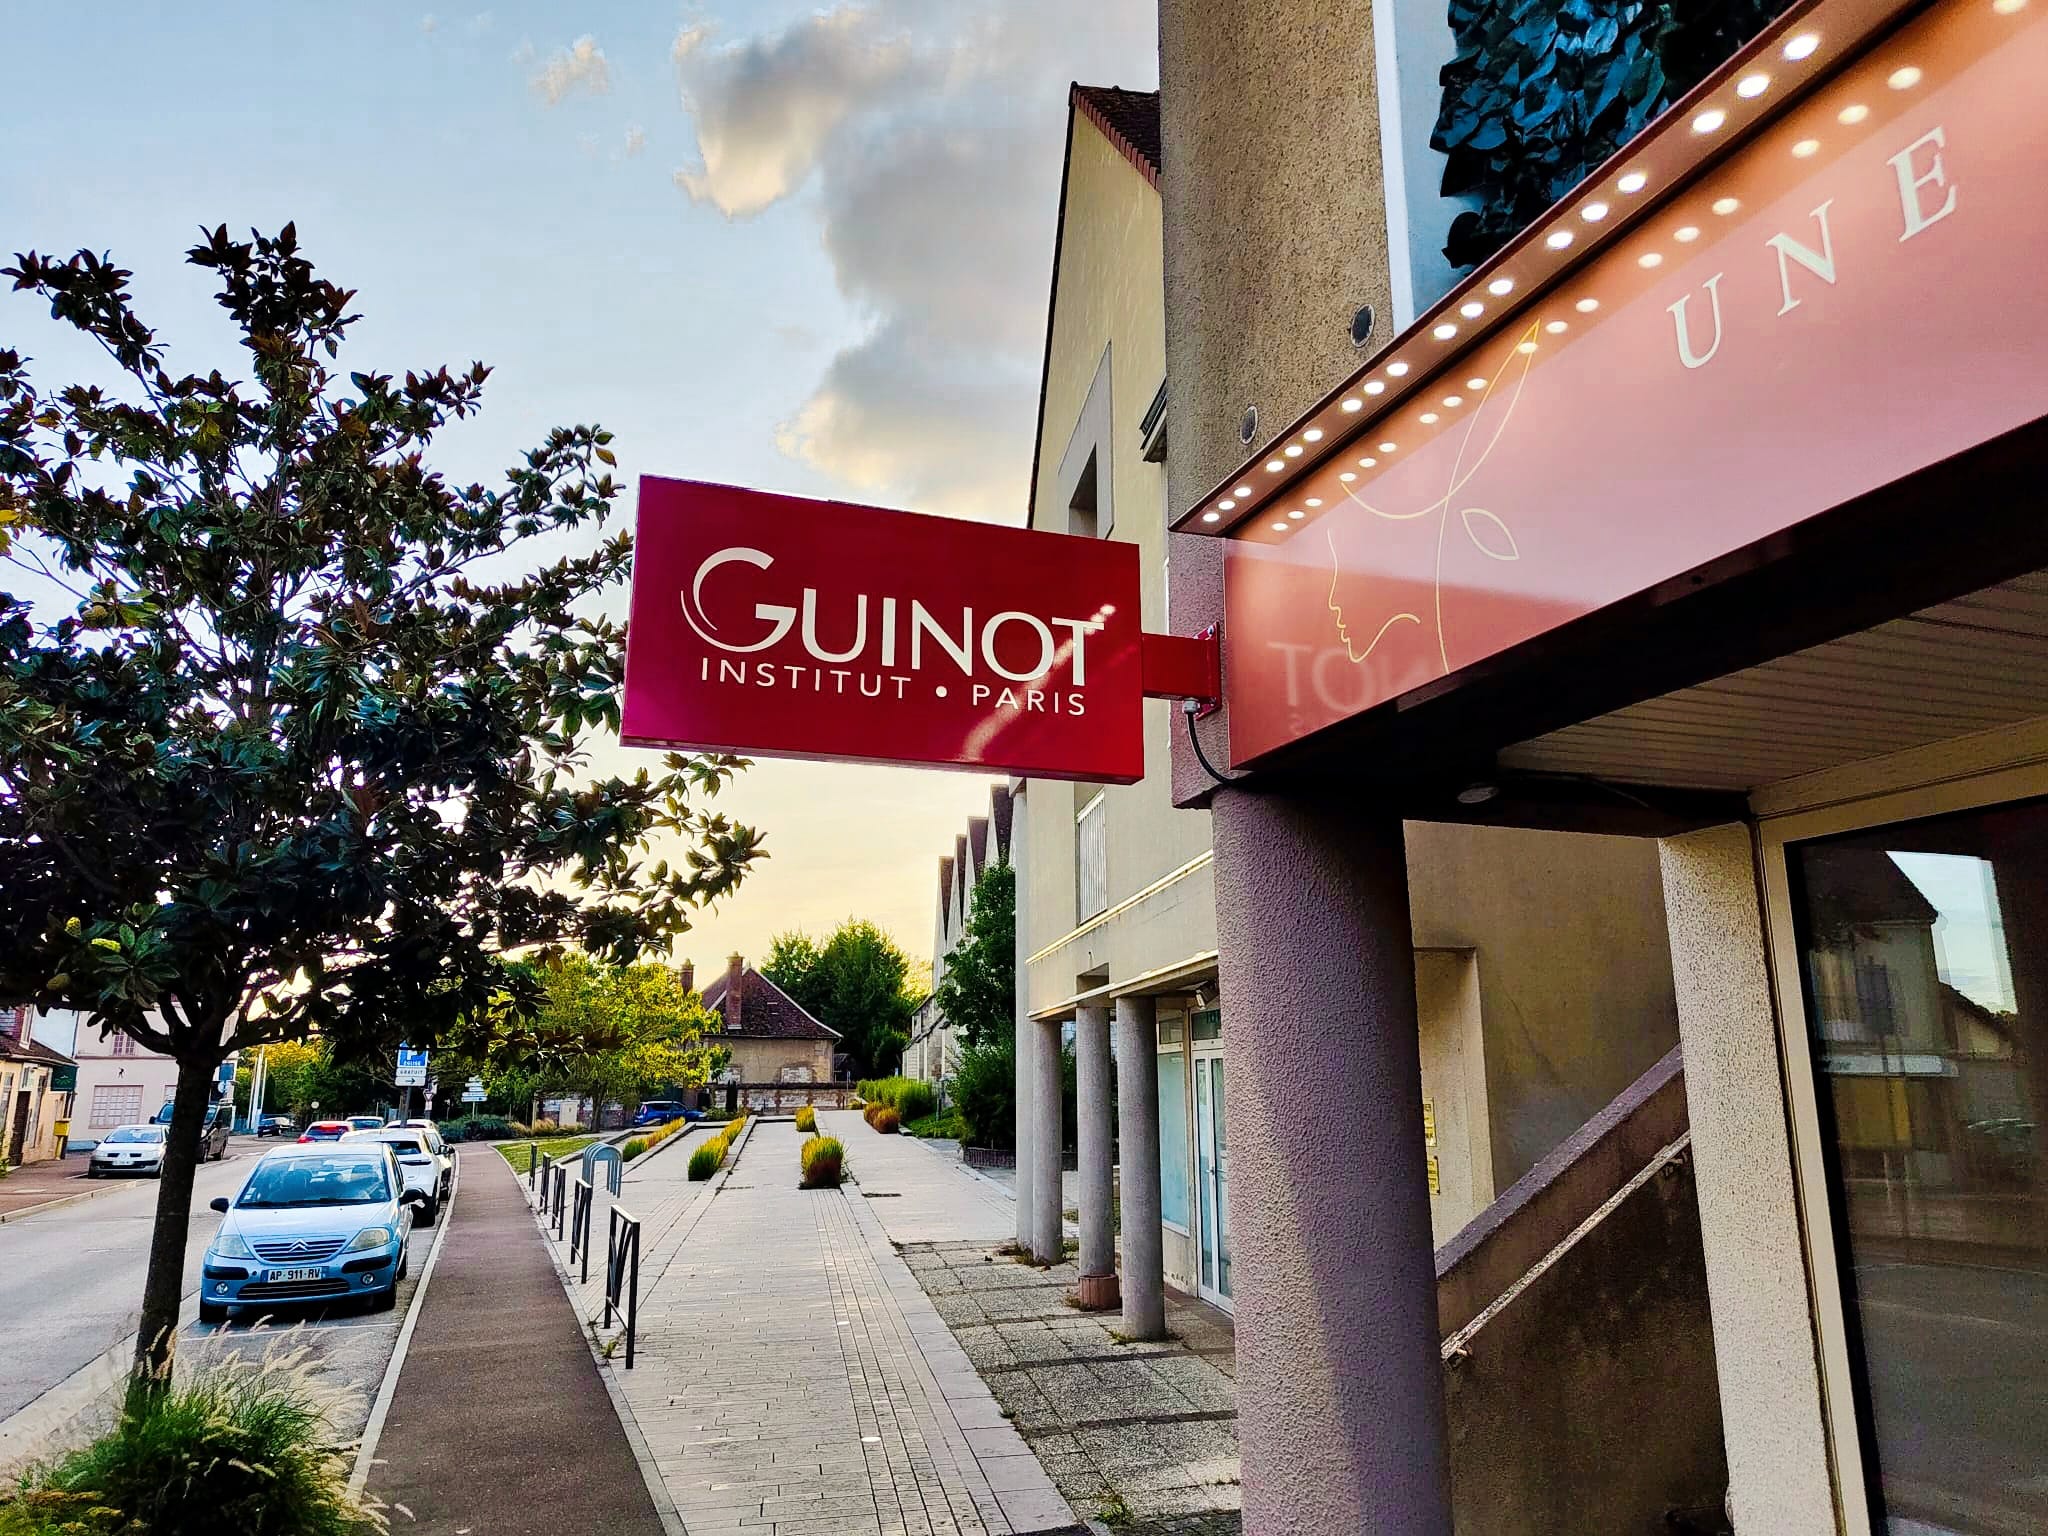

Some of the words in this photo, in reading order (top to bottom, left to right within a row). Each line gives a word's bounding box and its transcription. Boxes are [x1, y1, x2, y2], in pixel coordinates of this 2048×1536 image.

[1666, 125, 1958, 369] UNE
[680, 546, 1105, 687] GUINOT
[701, 657, 912, 699] INSTITUT
[972, 683, 1086, 717] PARIS
